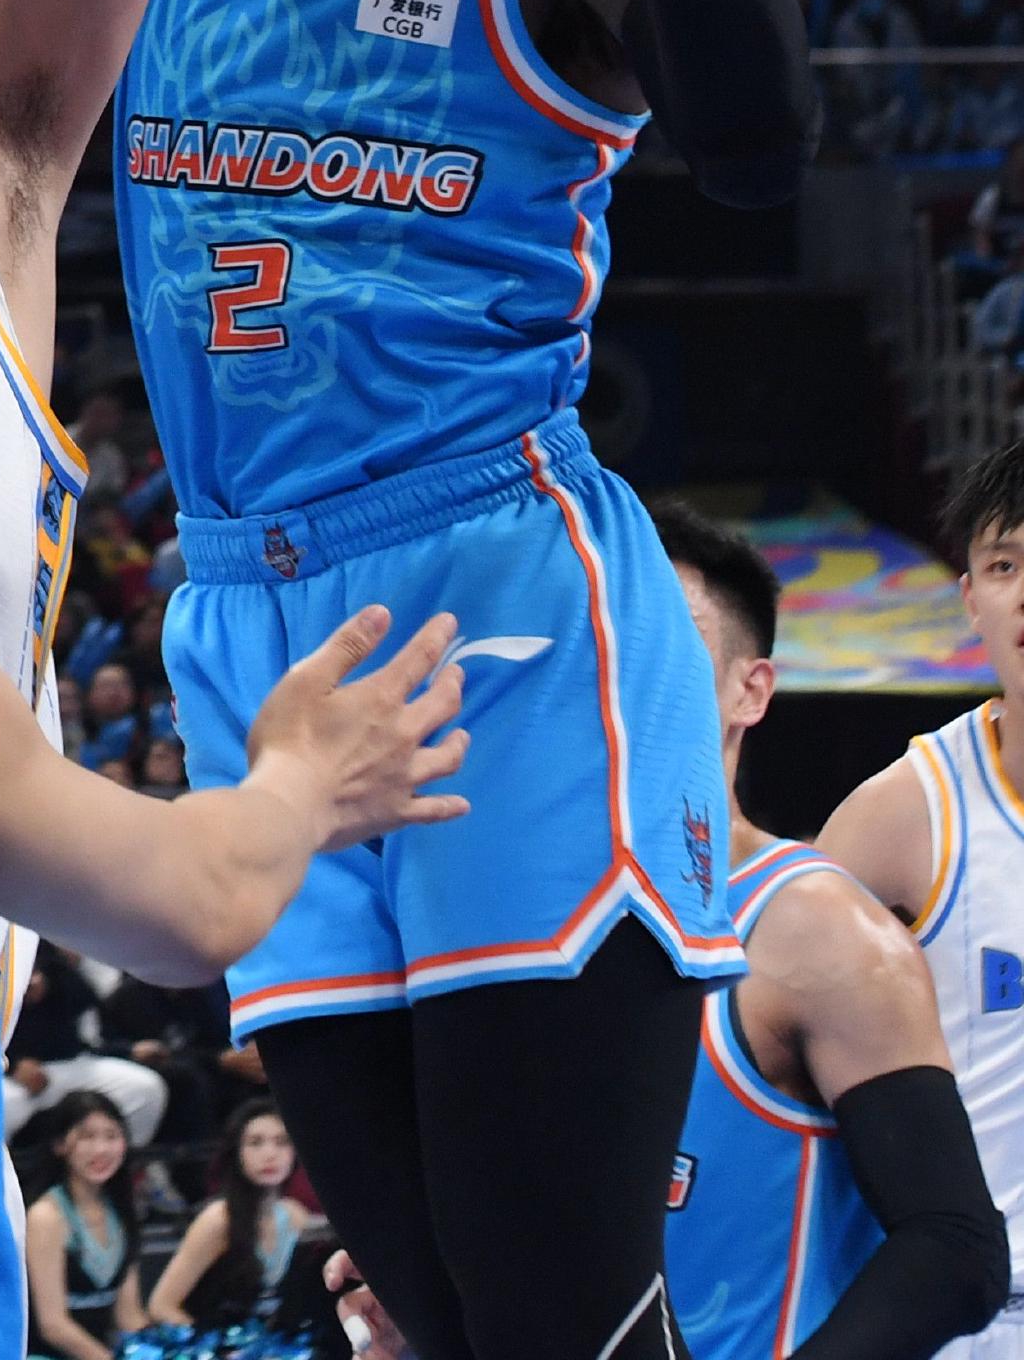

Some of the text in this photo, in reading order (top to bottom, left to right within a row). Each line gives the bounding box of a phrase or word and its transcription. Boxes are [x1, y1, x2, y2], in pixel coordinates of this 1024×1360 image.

[382, 15, 424, 39] CGB
[126, 115, 484, 217] SHANDONG
[206, 238, 294, 356] 2
